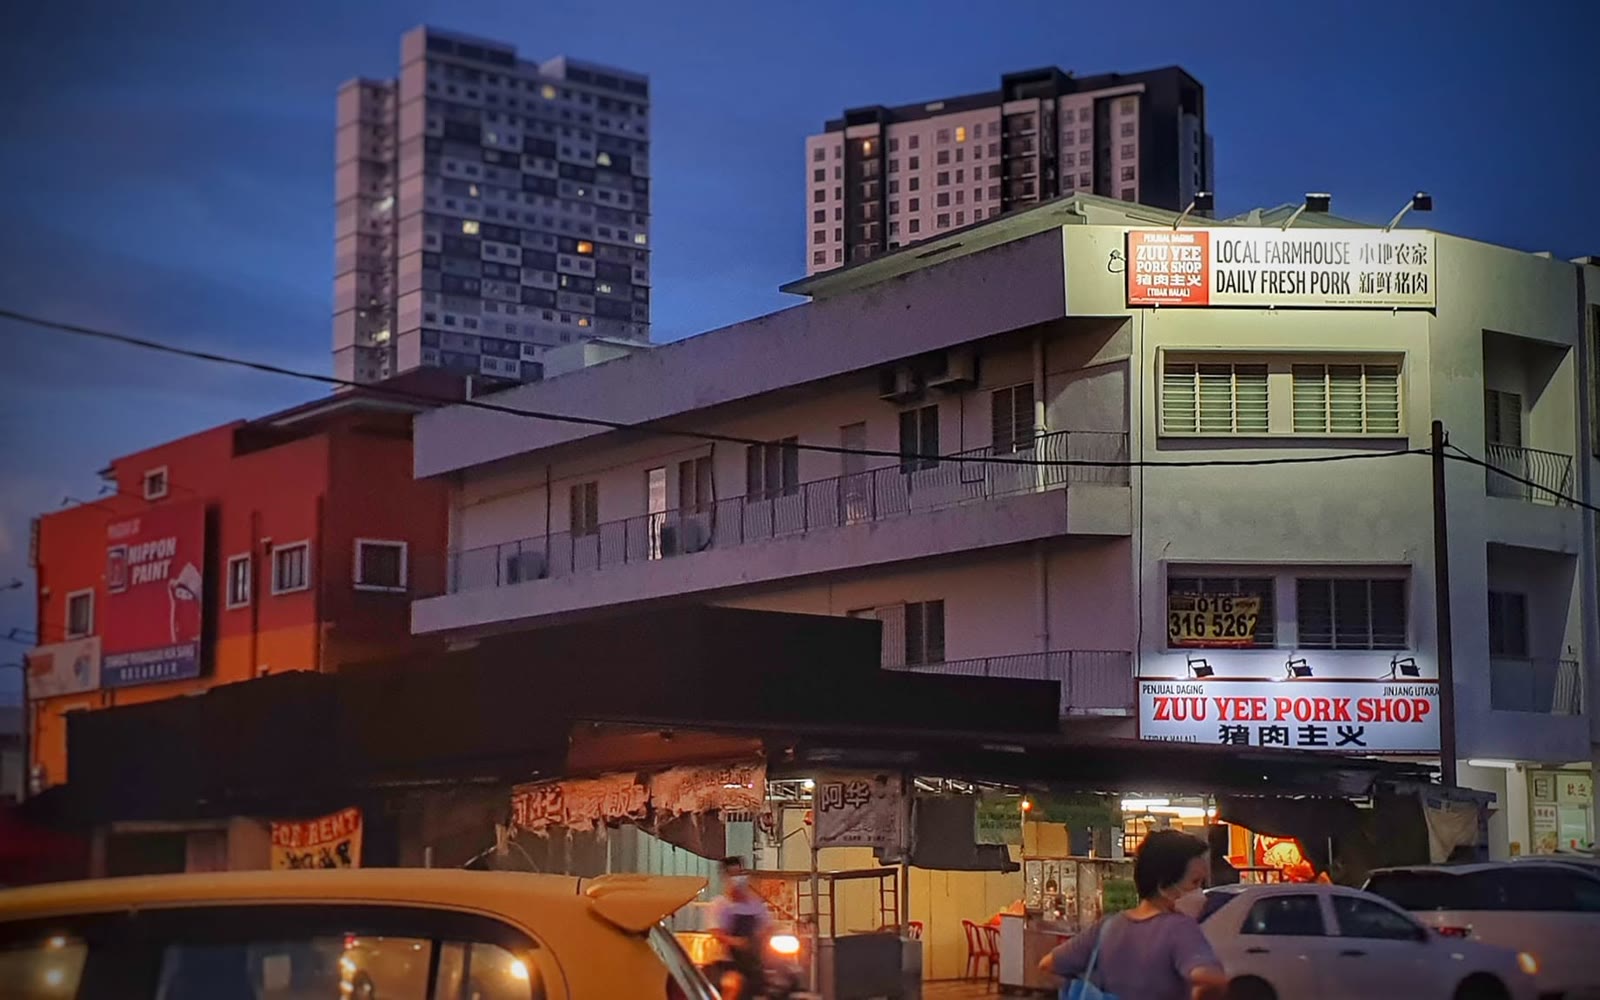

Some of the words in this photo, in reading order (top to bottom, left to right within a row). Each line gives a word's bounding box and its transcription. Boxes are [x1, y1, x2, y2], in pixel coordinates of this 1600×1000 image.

[1136, 245, 1168, 260] ZUU
[1169, 245, 1202, 261] YEE
[1216, 240, 1260, 264] LOCAL
[1265, 241, 1350, 265] FARMHOUSE
[1136, 260, 1169, 273] PORK
[1170, 261, 1202, 273] SHOP
[1136, 273, 1202, 287] 猪肉主义
[1216, 270, 1257, 293] DAILY
[1261, 270, 1306, 294] FRESH
[1310, 271, 1350, 294] PORK
[1359, 271, 1428, 294] 新鲜猪肉
[128, 537, 177, 565] NIPPON
[131, 560, 172, 585] PAINT
[1198, 598, 1233, 613] 016
[1170, 613, 1206, 637] 316
[1212, 614, 1258, 637] 5262
[1142, 684, 1174, 695] PENJUAL
[1176, 684, 1204, 695] DAGING
[1383, 686, 1414, 697] JINJANG
[1414, 687, 1439, 697] UTARA
[1153, 697, 1208, 722] ZUU
[1212, 697, 1268, 722] YEE
[1273, 697, 1353, 723] PORK
[1356, 698, 1431, 723] SHOP
[1218, 724, 1367, 747] 猪肉主义
[272, 821, 303, 847] FOR
[308, 808, 359, 846] RENT
